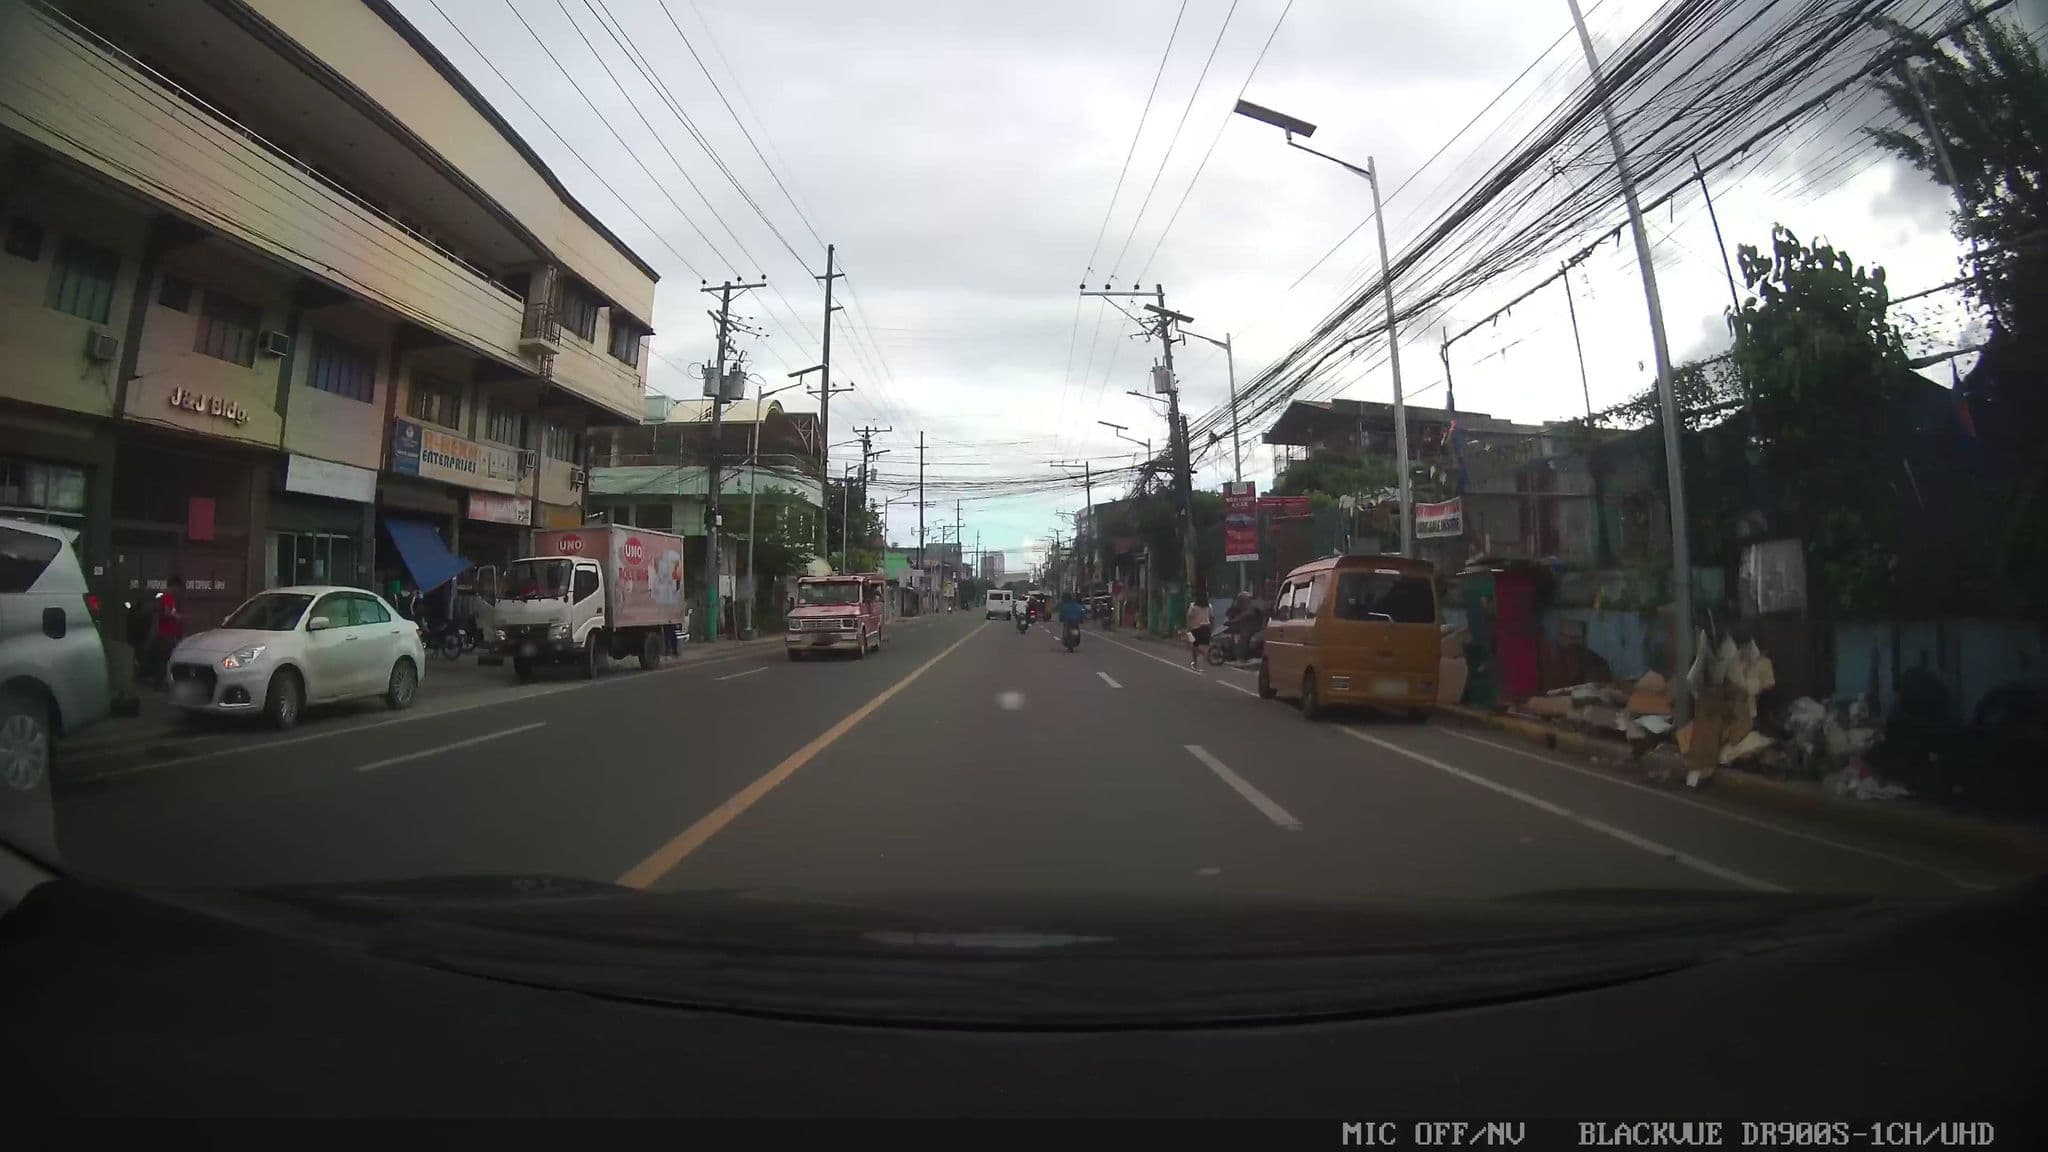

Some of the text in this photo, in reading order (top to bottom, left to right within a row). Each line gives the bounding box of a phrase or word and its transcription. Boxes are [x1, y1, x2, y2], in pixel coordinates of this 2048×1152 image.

[171, 386, 251, 425] J&J Bldg.
[422, 449, 477, 475] ENTERPRISES
[560, 539, 582, 552] UNO
[625, 543, 643, 559] UNO
